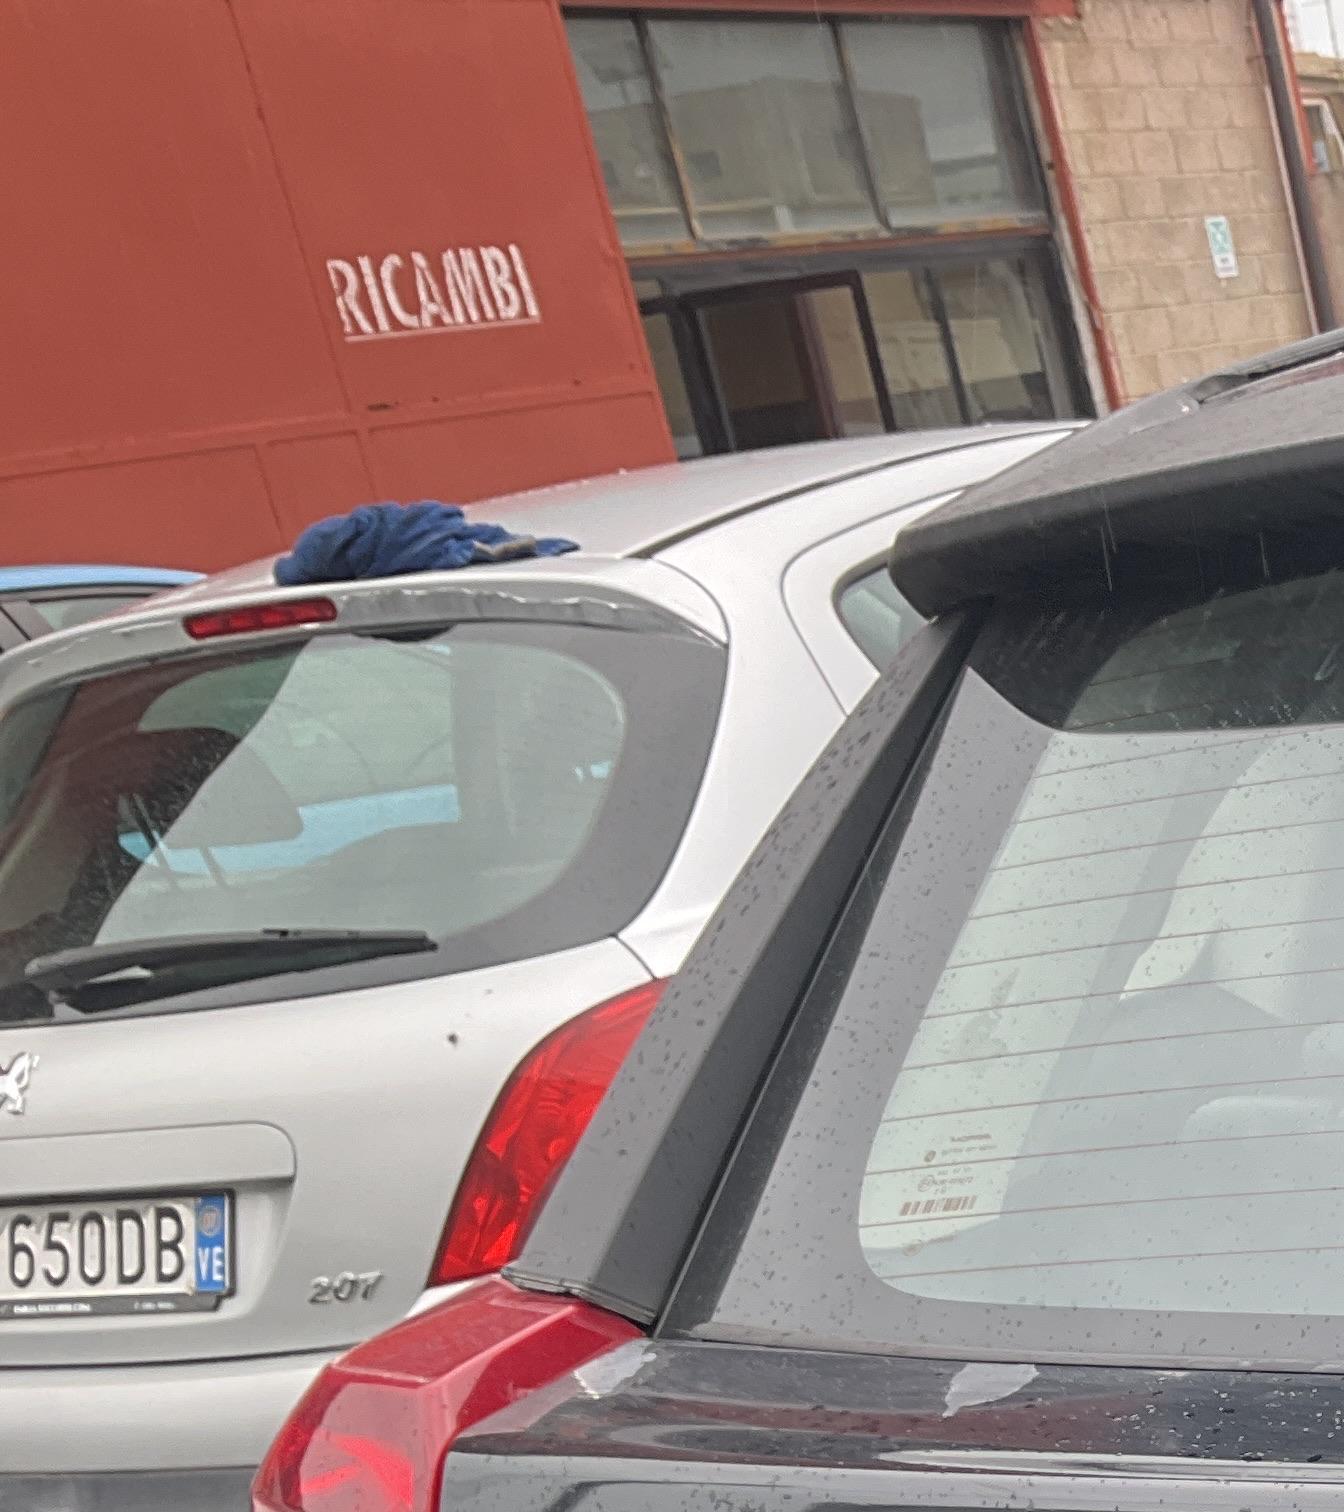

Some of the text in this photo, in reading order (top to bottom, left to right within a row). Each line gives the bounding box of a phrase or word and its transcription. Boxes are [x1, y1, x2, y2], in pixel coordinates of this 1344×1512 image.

[326, 243, 539, 334] RICAMBI
[198, 1247, 224, 1281] VE
[307, 1269, 383, 1304] 207
